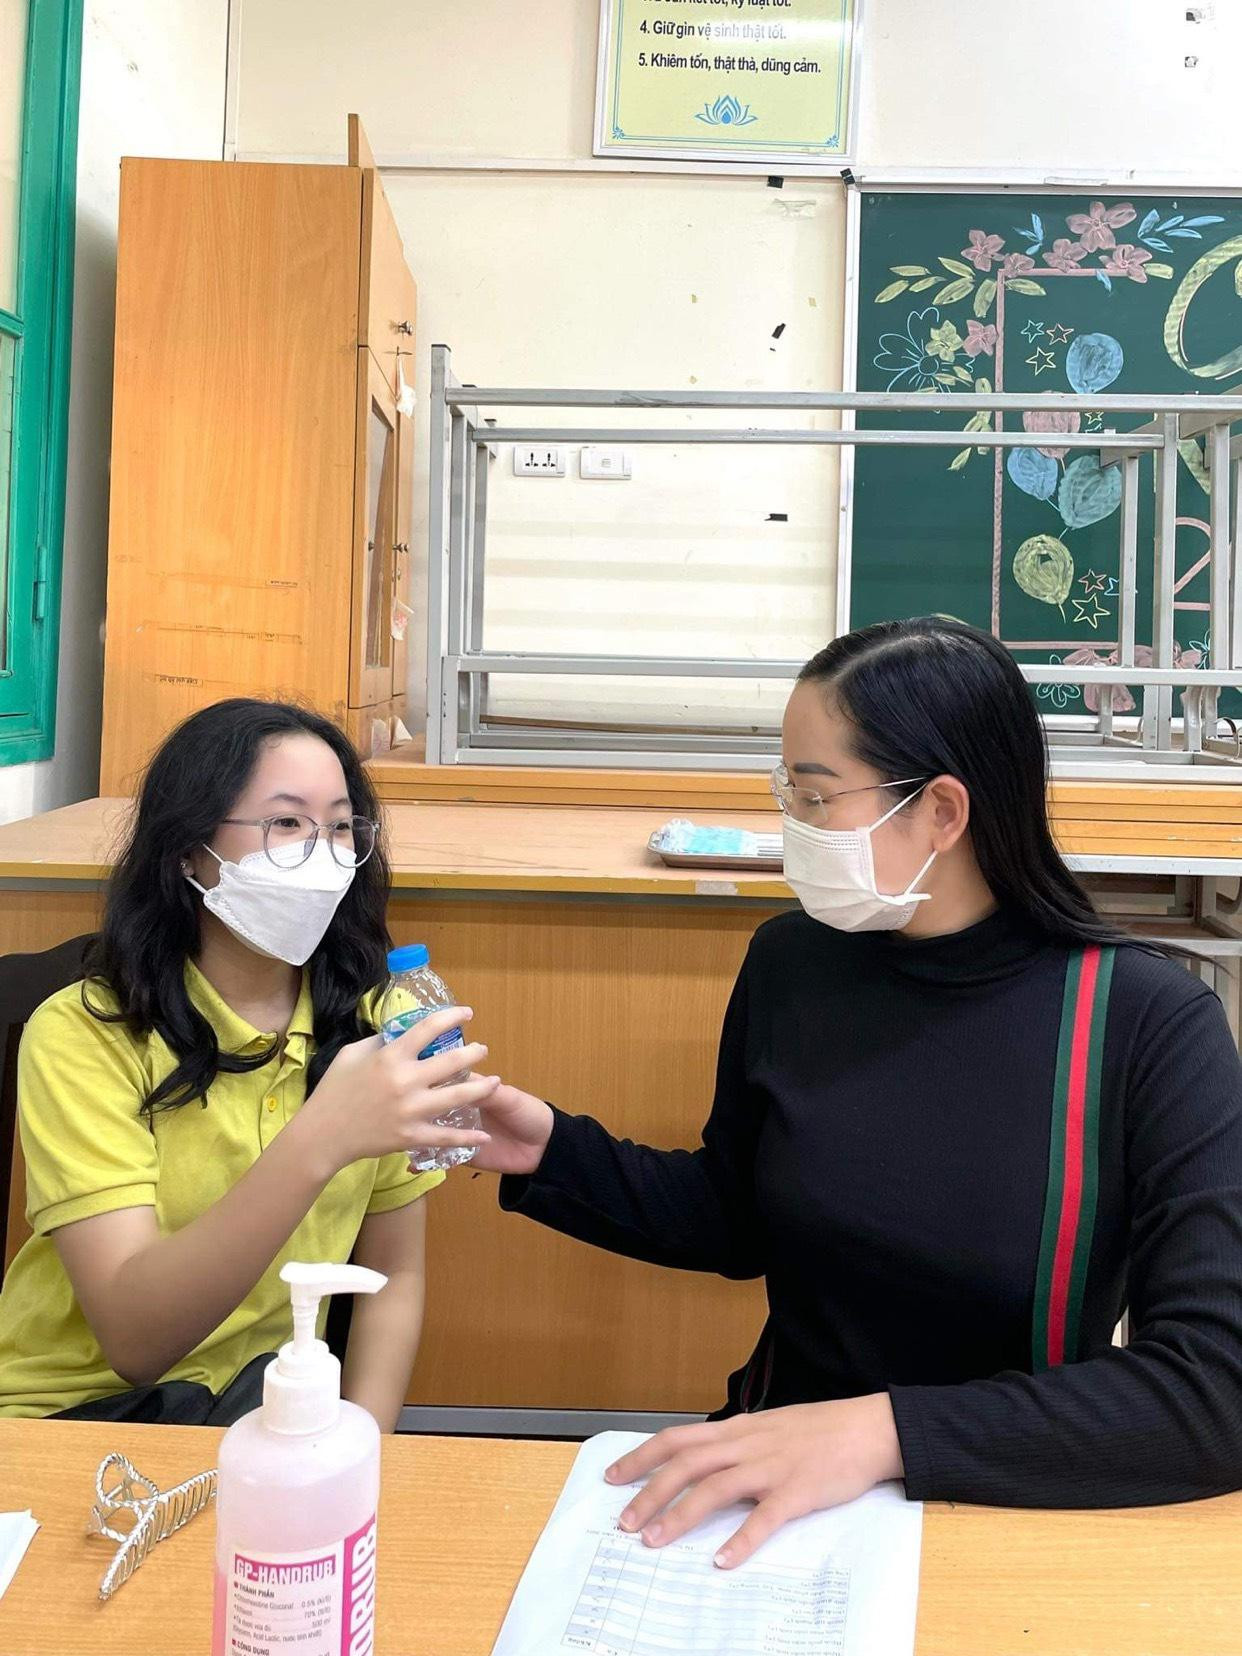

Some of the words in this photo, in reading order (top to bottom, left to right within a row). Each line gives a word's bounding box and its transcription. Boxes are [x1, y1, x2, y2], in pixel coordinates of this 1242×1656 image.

[639, 19, 650, 34] 4.
[652, 20, 676, 35] Giữ
[697, 23, 711, 41] vệ
[714, 23, 739, 38] sinh
[742, 23, 765, 43] thật
[638, 52, 648, 67] 5.
[650, 52, 687, 69] Khiêm
[690, 53, 711, 72] tốn,
[714, 55, 736, 74] thật
[738, 56, 759, 73] thà,
[761, 57, 791, 76] dũng
[793, 57, 822, 74] cảm.
[236, 1558, 333, 1584] GP-HANDRUB
